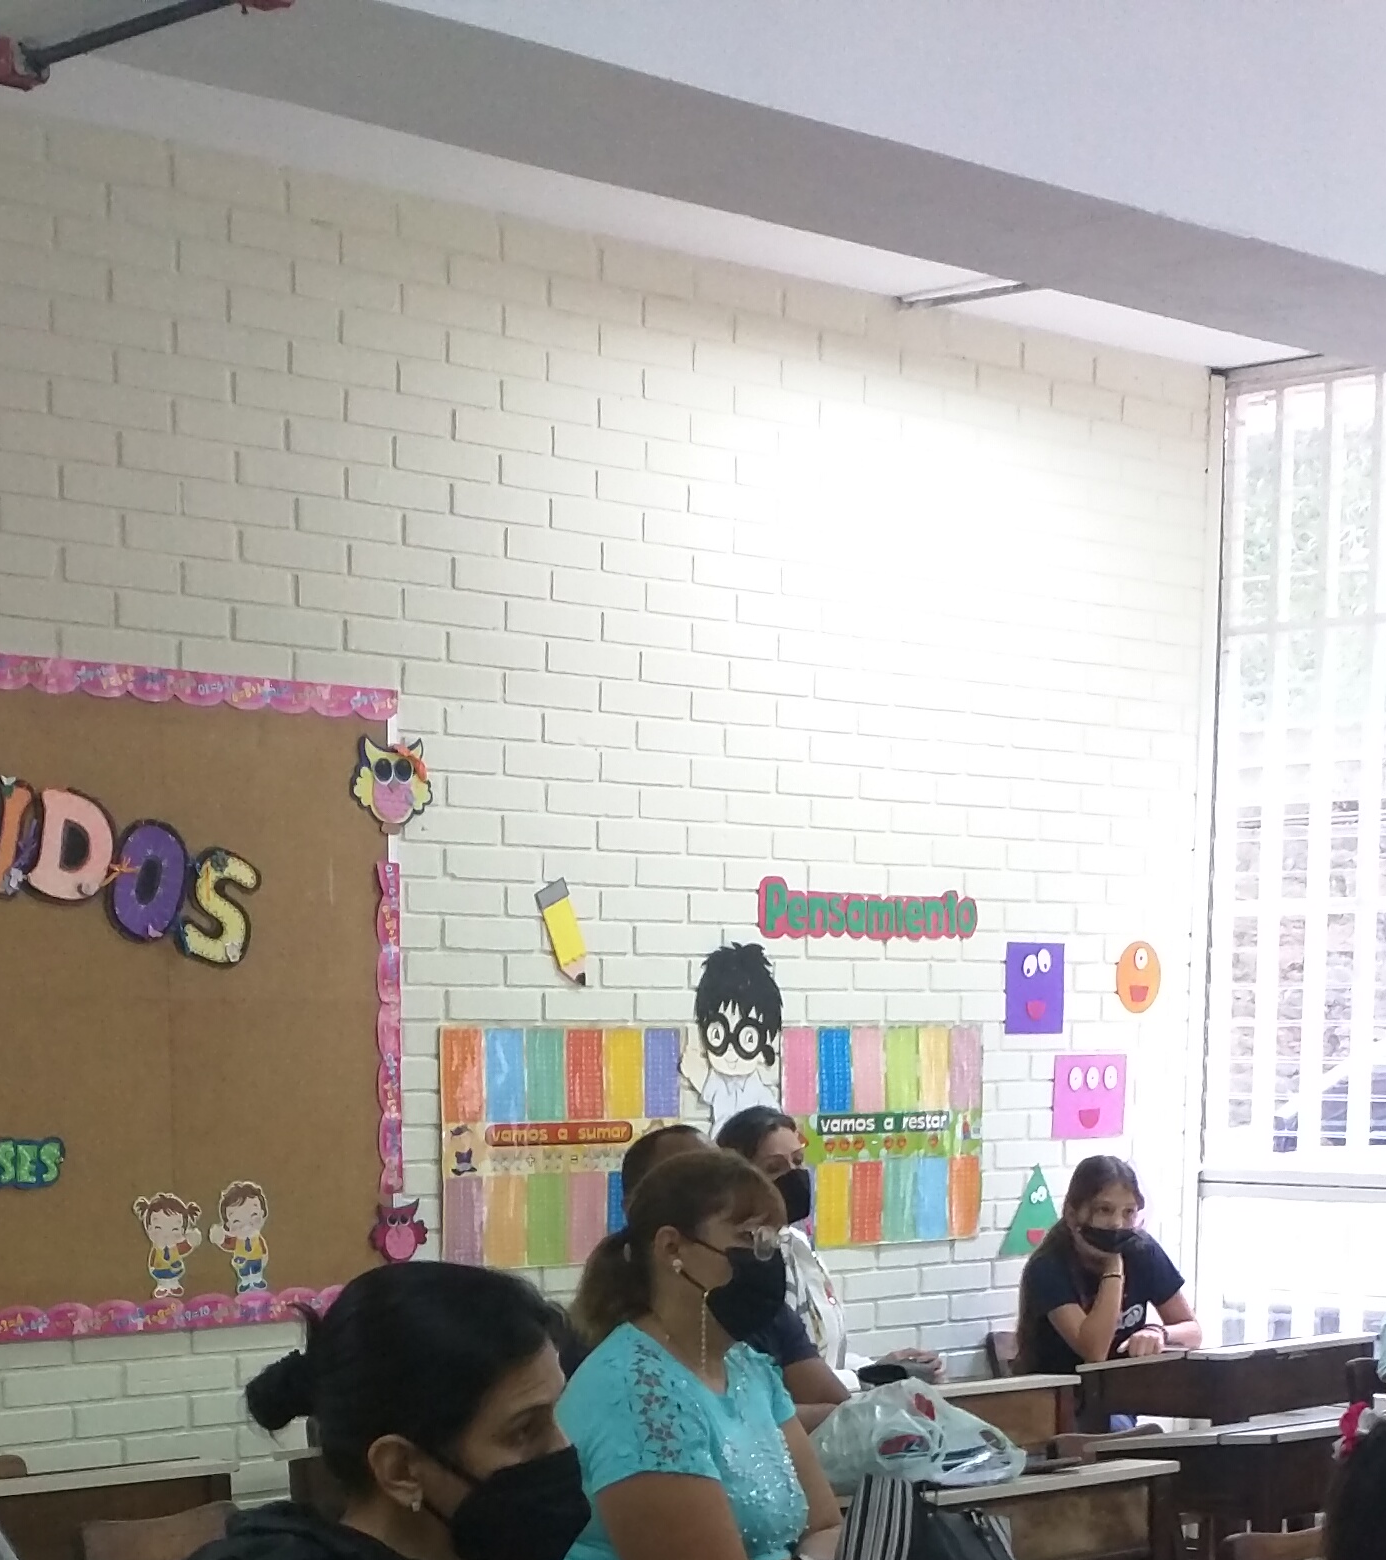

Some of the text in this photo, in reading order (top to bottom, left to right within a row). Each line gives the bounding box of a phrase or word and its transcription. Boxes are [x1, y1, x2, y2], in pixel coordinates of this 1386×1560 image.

[764, 883, 978, 935] Pensamiento
[491, 1120, 629, 1143] vamos a sumar
[820, 1112, 949, 1133] vamos a restar
